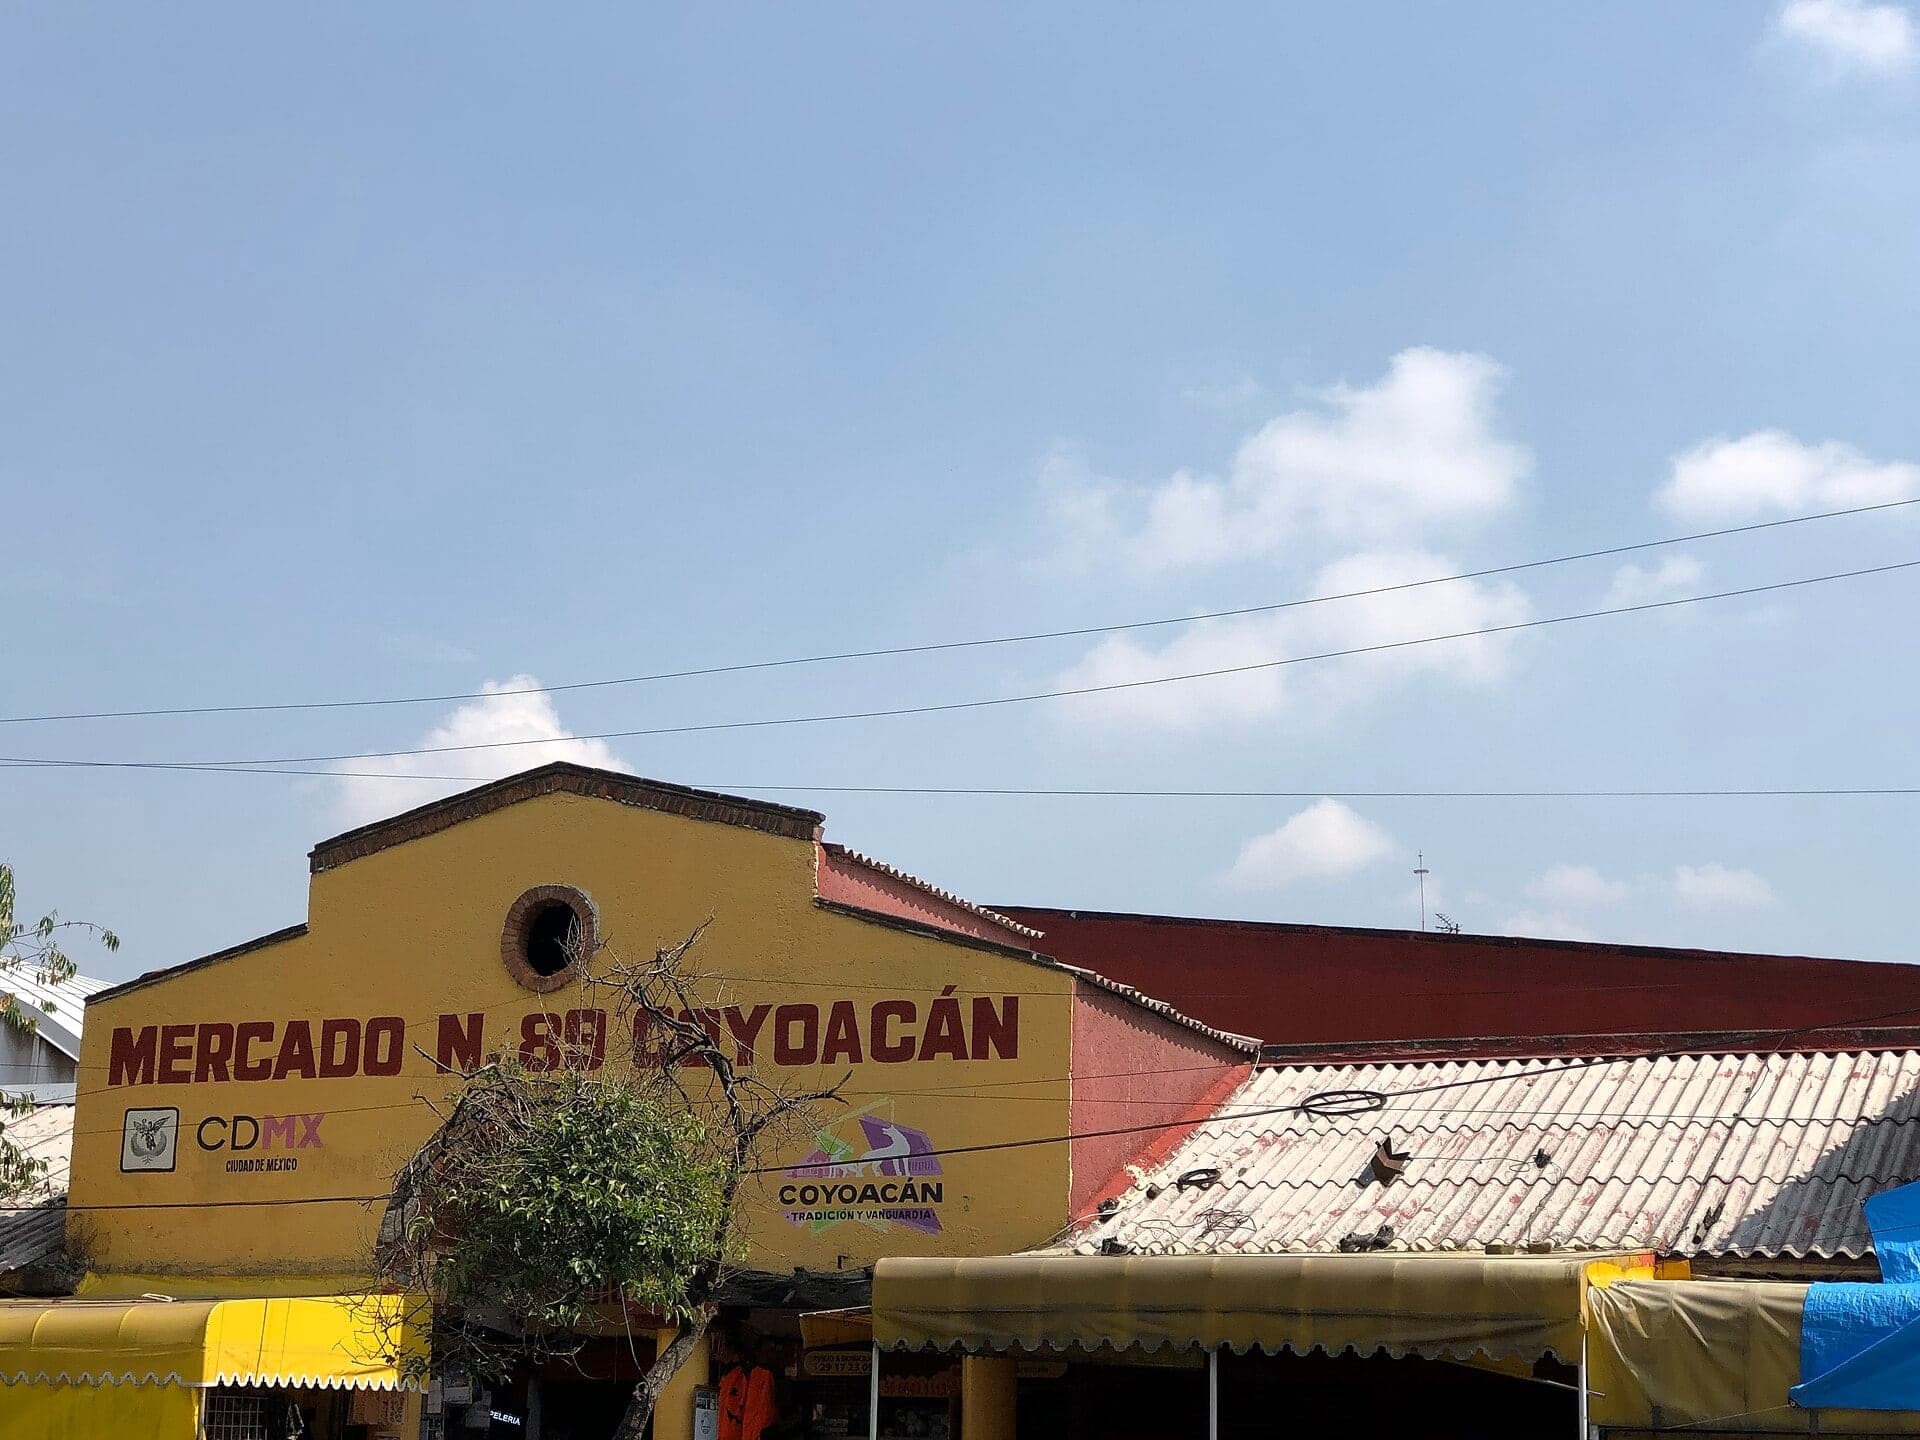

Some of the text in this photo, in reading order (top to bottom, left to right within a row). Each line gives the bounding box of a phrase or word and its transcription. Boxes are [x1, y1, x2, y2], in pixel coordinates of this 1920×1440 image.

[107, 1016, 405, 1086] MERCADO
[519, 1008, 607, 1073] 89
[632, 985, 1019, 1069] COYOACÁN
[197, 1112, 325, 1151] CDMX
[225, 1155, 297, 1172] CIUDAD DE MÉXICO
[779, 1177, 943, 1205] COYOACÁN
[856, 1210, 864, 1219] Y
[866, 1208, 931, 1220] VANGUARDIA
